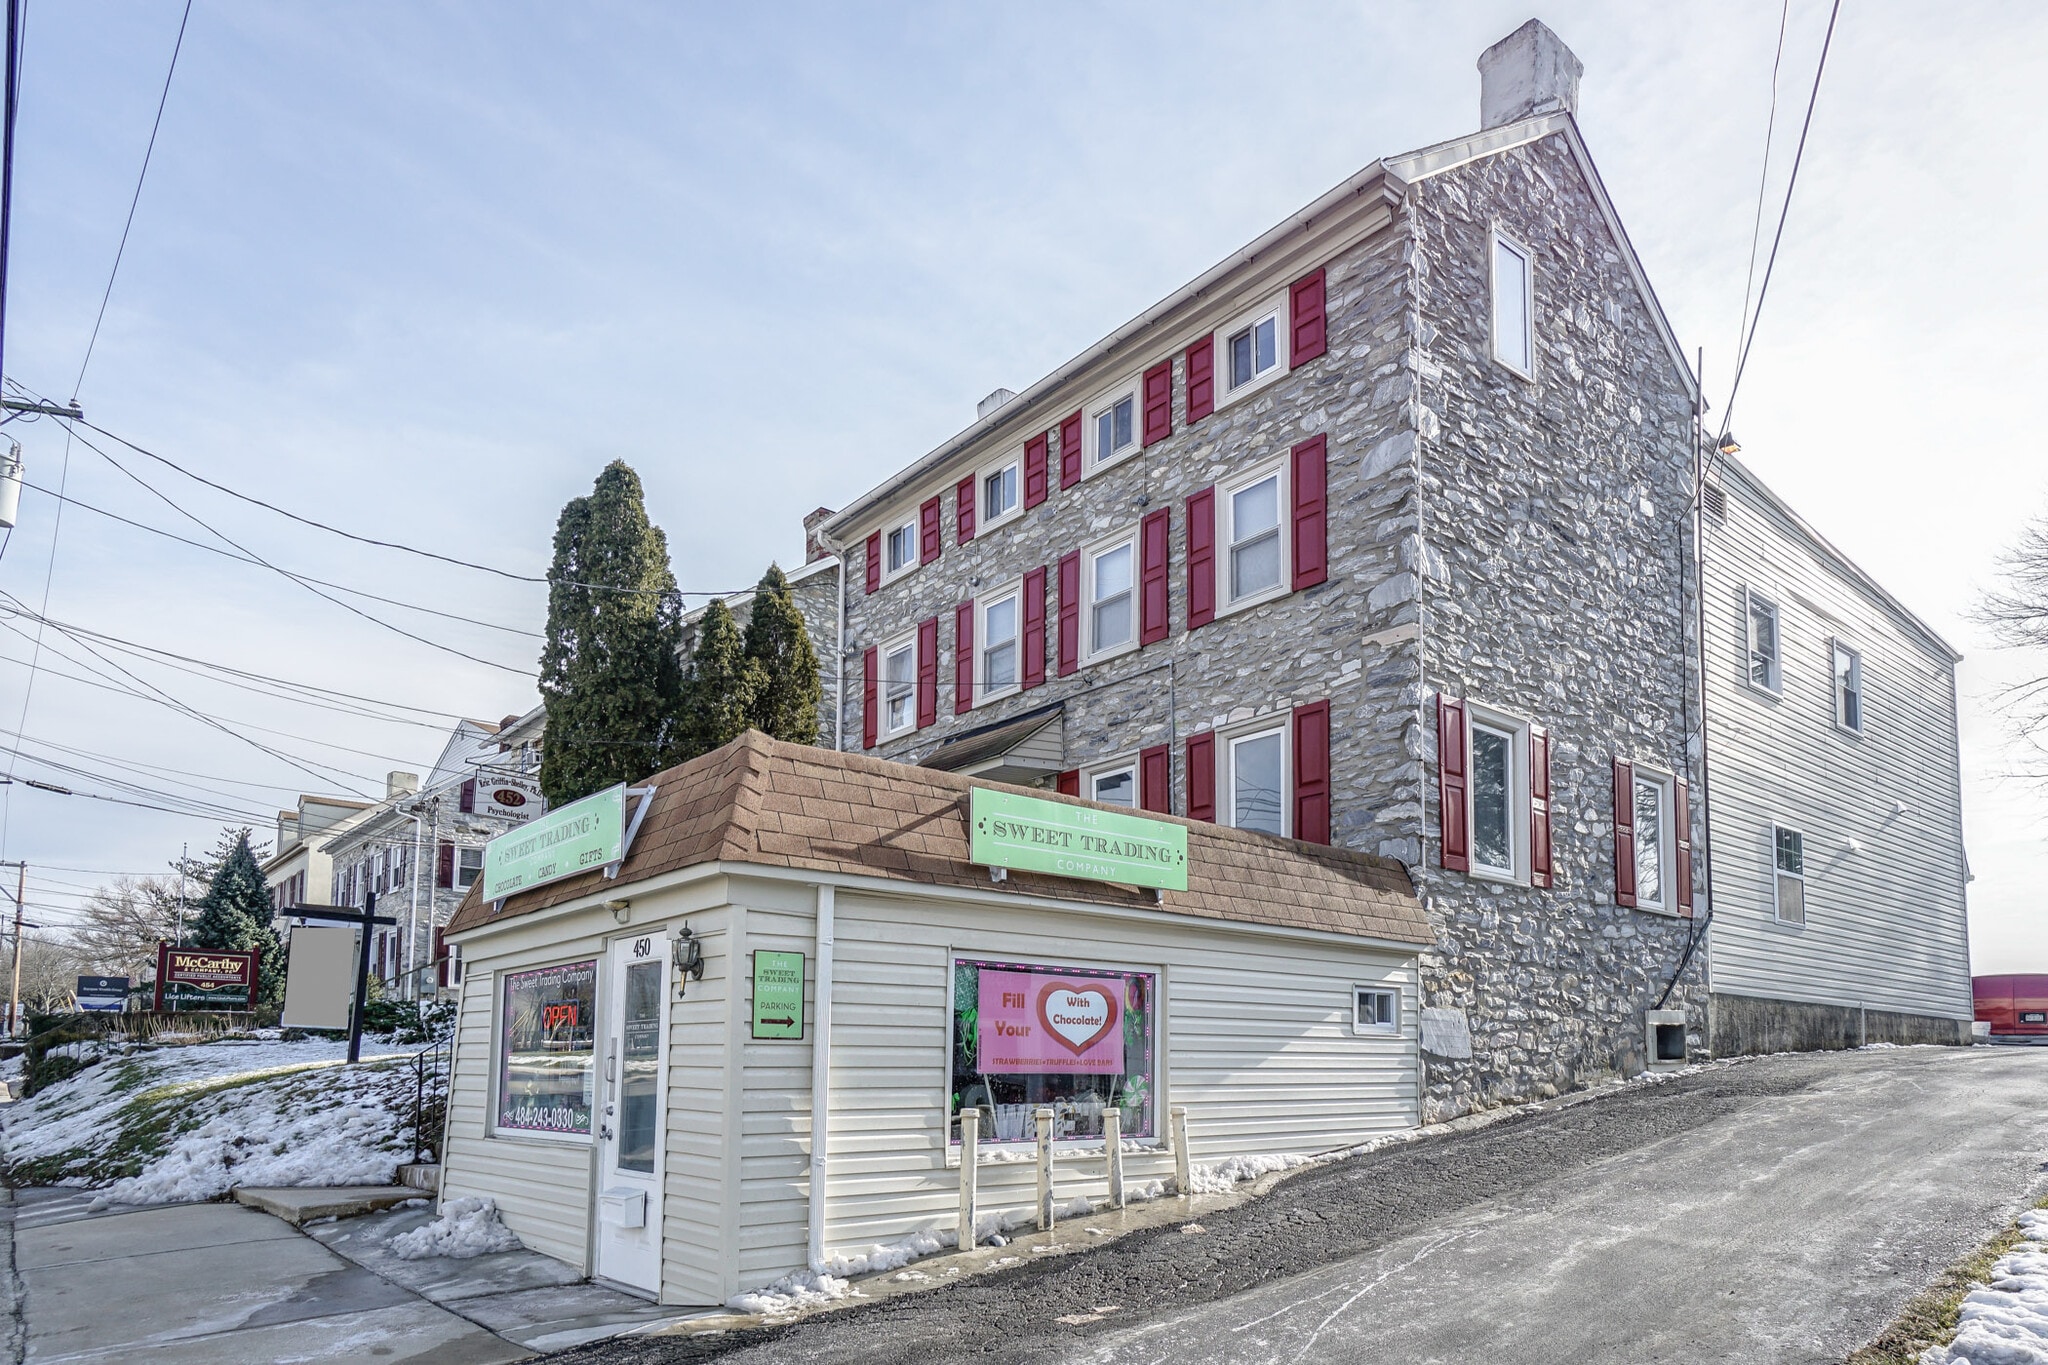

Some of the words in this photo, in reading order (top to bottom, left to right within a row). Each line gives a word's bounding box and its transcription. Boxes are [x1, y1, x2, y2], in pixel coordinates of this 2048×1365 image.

[497, 790, 520, 805] 452
[487, 806, 529, 820] Psychologist
[1076, 811, 1098, 825] THE
[504, 837, 538, 862] SWEET
[540, 817, 590, 848] TRADING
[992, 820, 1073, 848] SWEET
[1080, 834, 1172, 863] TRADING
[494, 875, 522, 893] CHOCOLATE
[537, 863, 557, 879] CANDY
[579, 848, 603, 865] GIFTS
[1057, 859, 1116, 877] COMPANY
[633, 937, 651, 958] 450
[174, 955, 243, 973] McCarthy
[772, 960, 788, 968] THE
[510, 978, 520, 991] The
[520, 976, 538, 990] Sweet
[538, 973, 561, 988] Trading
[562, 968, 594, 984] Company
[758, 976, 799, 984] TRADING
[763, 969, 795, 977] SWEET
[164, 993, 179, 1001] Lice
[180, 994, 206, 1002] Lifters
[757, 985, 800, 994] COMPANY
[760, 1002, 797, 1012] PARKING
[1002, 992, 1026, 1010] Fill
[1066, 997, 1091, 1009] With
[543, 1005, 577, 1029] OPEN
[1053, 1014, 1103, 1027] Chocolate!
[994, 1021, 1032, 1038] Your
[515, 1106, 574, 1129] 484-243-0330
